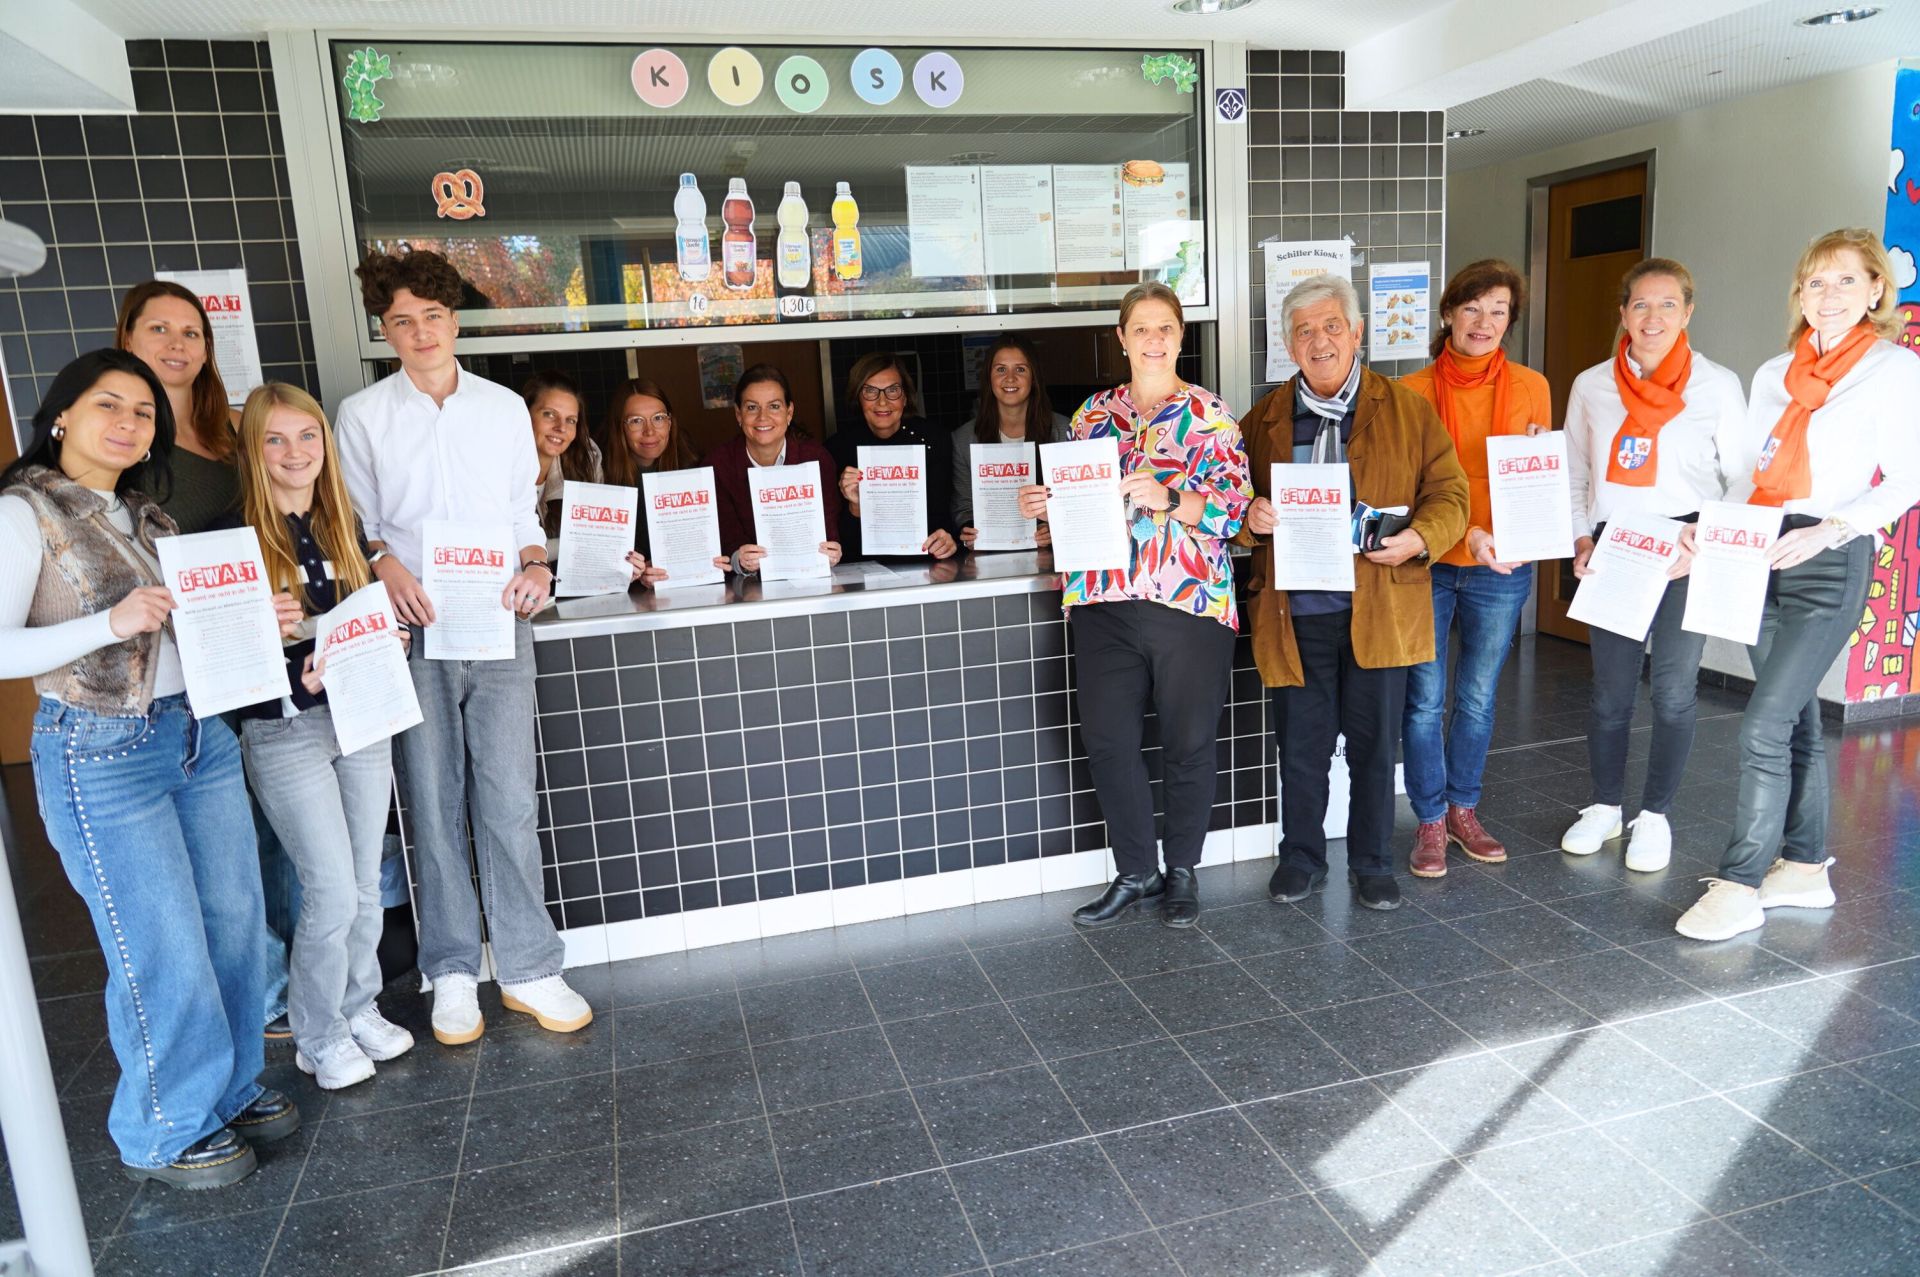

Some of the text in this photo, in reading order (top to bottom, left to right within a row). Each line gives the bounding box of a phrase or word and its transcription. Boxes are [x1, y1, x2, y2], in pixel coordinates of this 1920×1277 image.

[1314, 249, 1338, 260] Kiosk
[866, 465, 919, 480] GEWALT
[979, 463, 1030, 478] GEWALT
[1052, 464, 1112, 484] GEWALT
[1498, 455, 1559, 475] GEWALT
[654, 490, 710, 510] GEWALT
[760, 485, 815, 503] GEWALT
[1280, 488, 1341, 505] GEWALT
[571, 505, 630, 525] GEWALT
[1610, 528, 1674, 558] GEWALT
[1704, 526, 1768, 548] GEWALT
[434, 547, 504, 568] GEWALT
[178, 561, 259, 593] GEWALT
